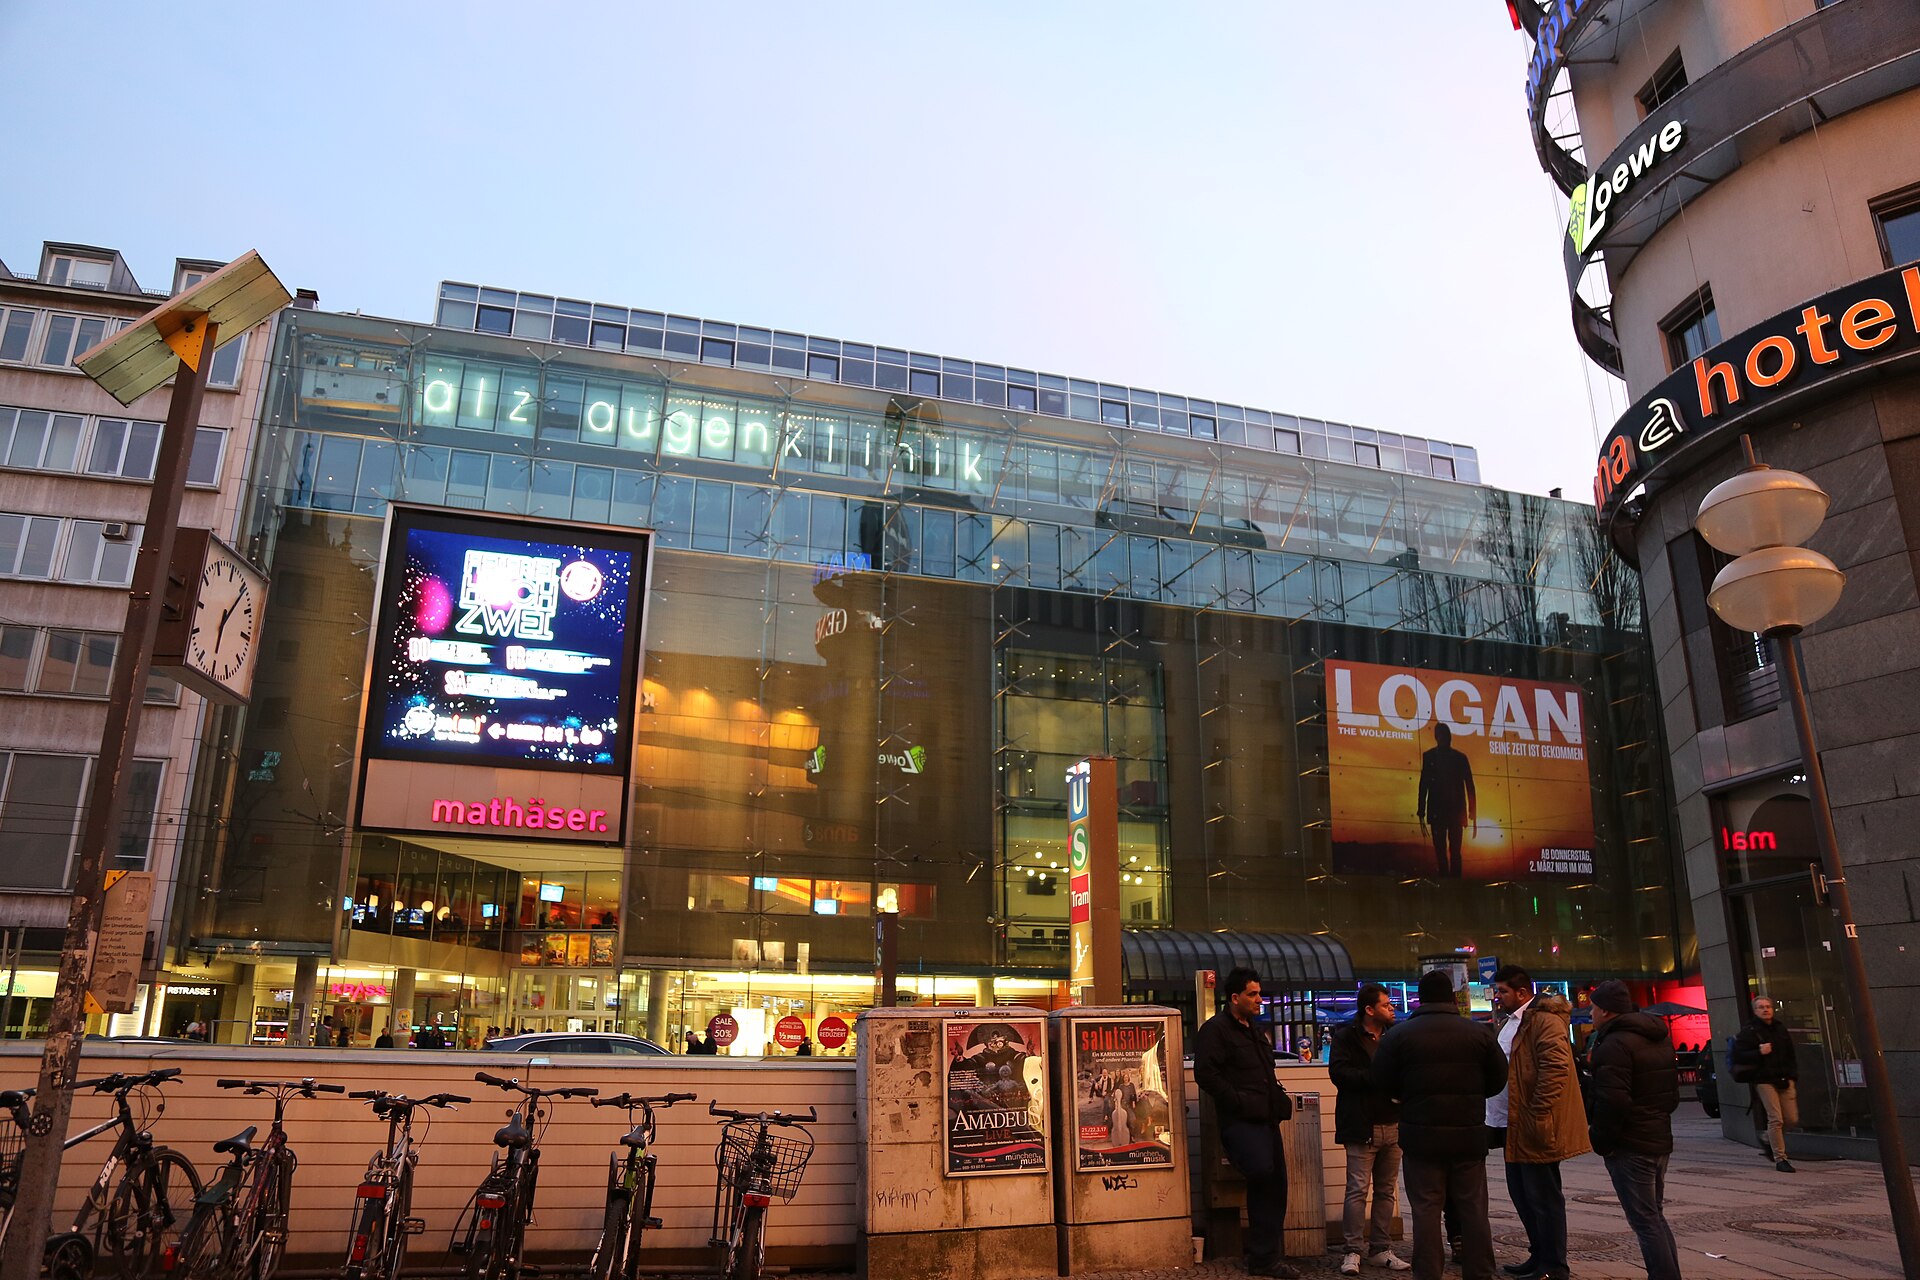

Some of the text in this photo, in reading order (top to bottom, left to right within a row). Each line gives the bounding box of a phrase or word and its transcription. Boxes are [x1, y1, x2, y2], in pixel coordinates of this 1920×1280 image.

[1581, 119, 1683, 253] Loewe
[1693, 266, 1920, 417] hotel
[424, 376, 530, 422] alz
[456, 604, 554, 641] ZWEI
[1335, 668, 1582, 744] LOGAN
[1338, 727, 1413, 740] THE WOLVERINE
[1489, 741, 1584, 760] SEINE ZEIT IST GEKOMMEN
[1072, 778, 1084, 816] U
[431, 797, 608, 833] mathäser.
[1073, 827, 1086, 867] S
[1541, 848, 1592, 862] AB DONNERSTAG,
[1530, 860, 1592, 874] 2. MÄRZ NUR IM KINO
[1071, 890, 1089, 908] Tram
[331, 981, 387, 1001] KRASS
[715, 1018, 732, 1026] SALE
[714, 1030, 732, 1038] 50%
[952, 1106, 1040, 1132] AMADEUS
[986, 1129, 1010, 1140] LIVE
[1020, 1156, 1044, 1164] musik
